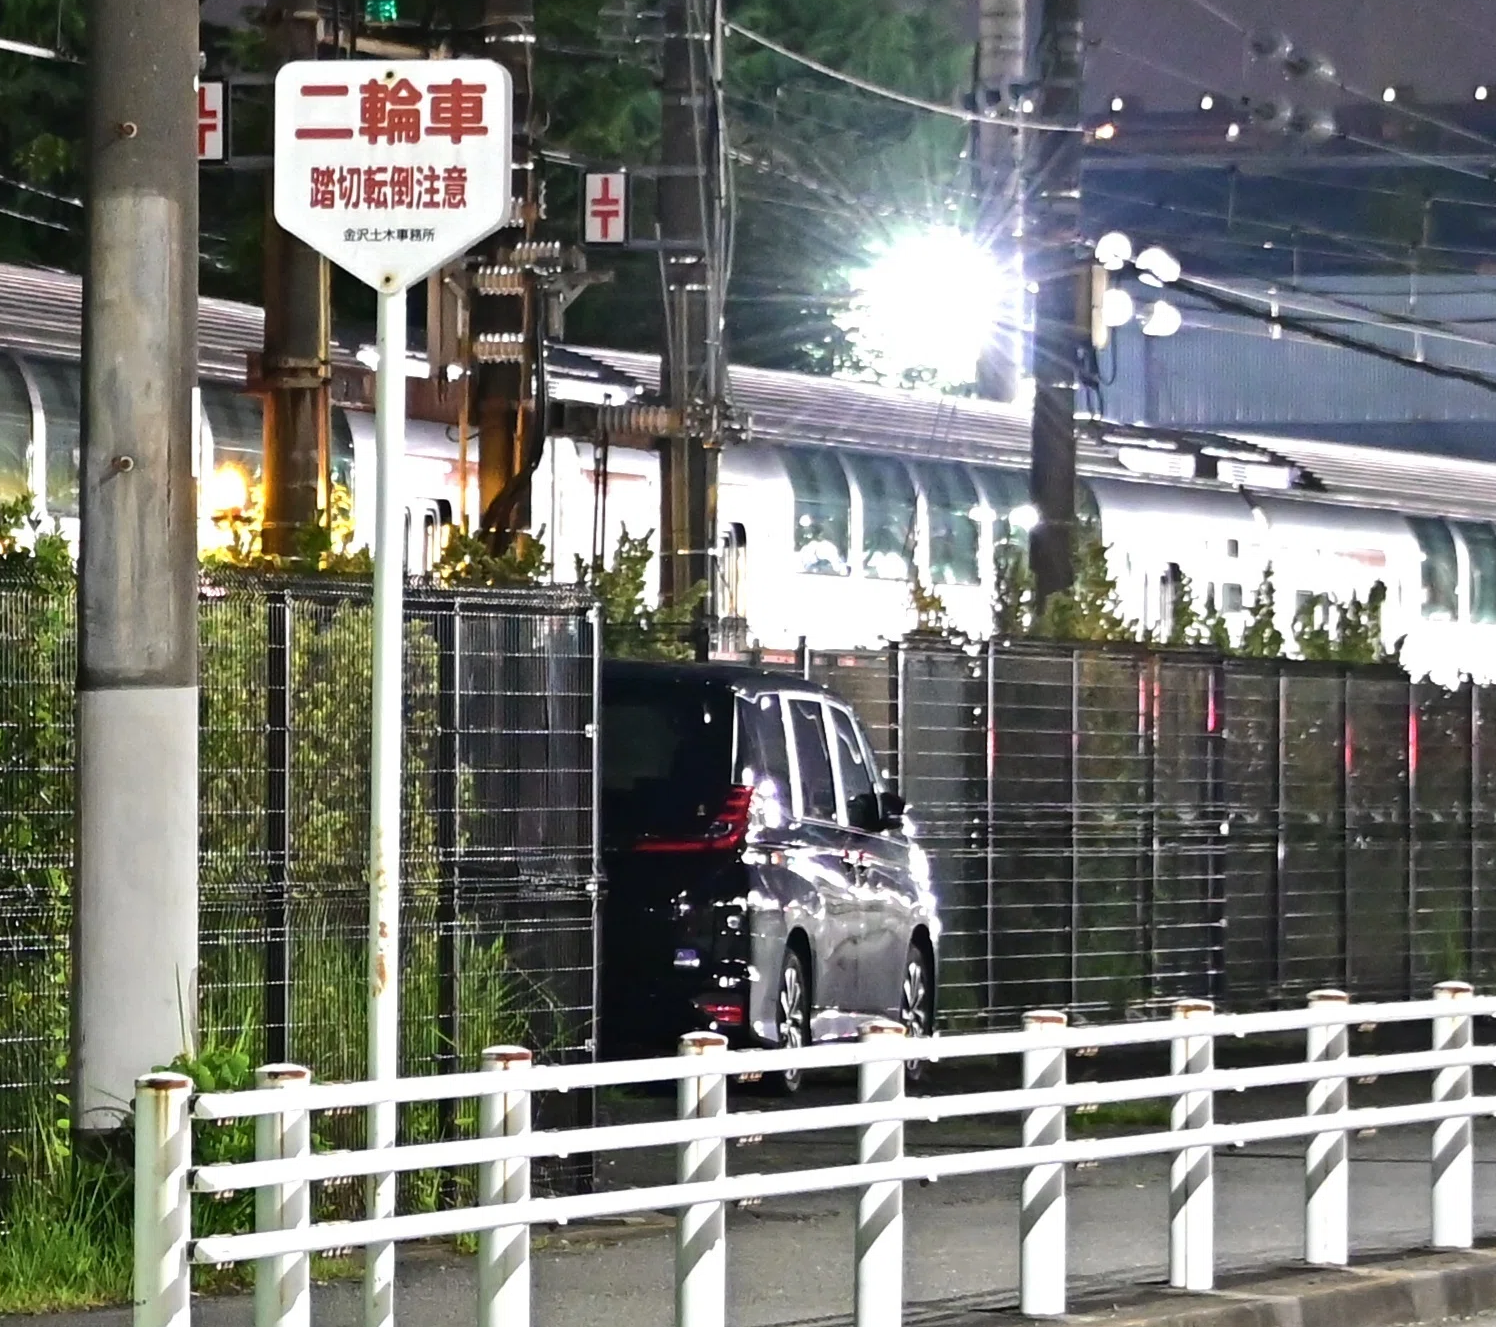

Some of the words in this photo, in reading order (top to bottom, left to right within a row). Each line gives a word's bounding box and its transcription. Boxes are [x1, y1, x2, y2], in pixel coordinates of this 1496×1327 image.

[295, 78, 488, 145] 二輪車
[310, 165, 468, 210] 踏切転倒注意
[343, 227, 435, 243] 金沢土木事務所
